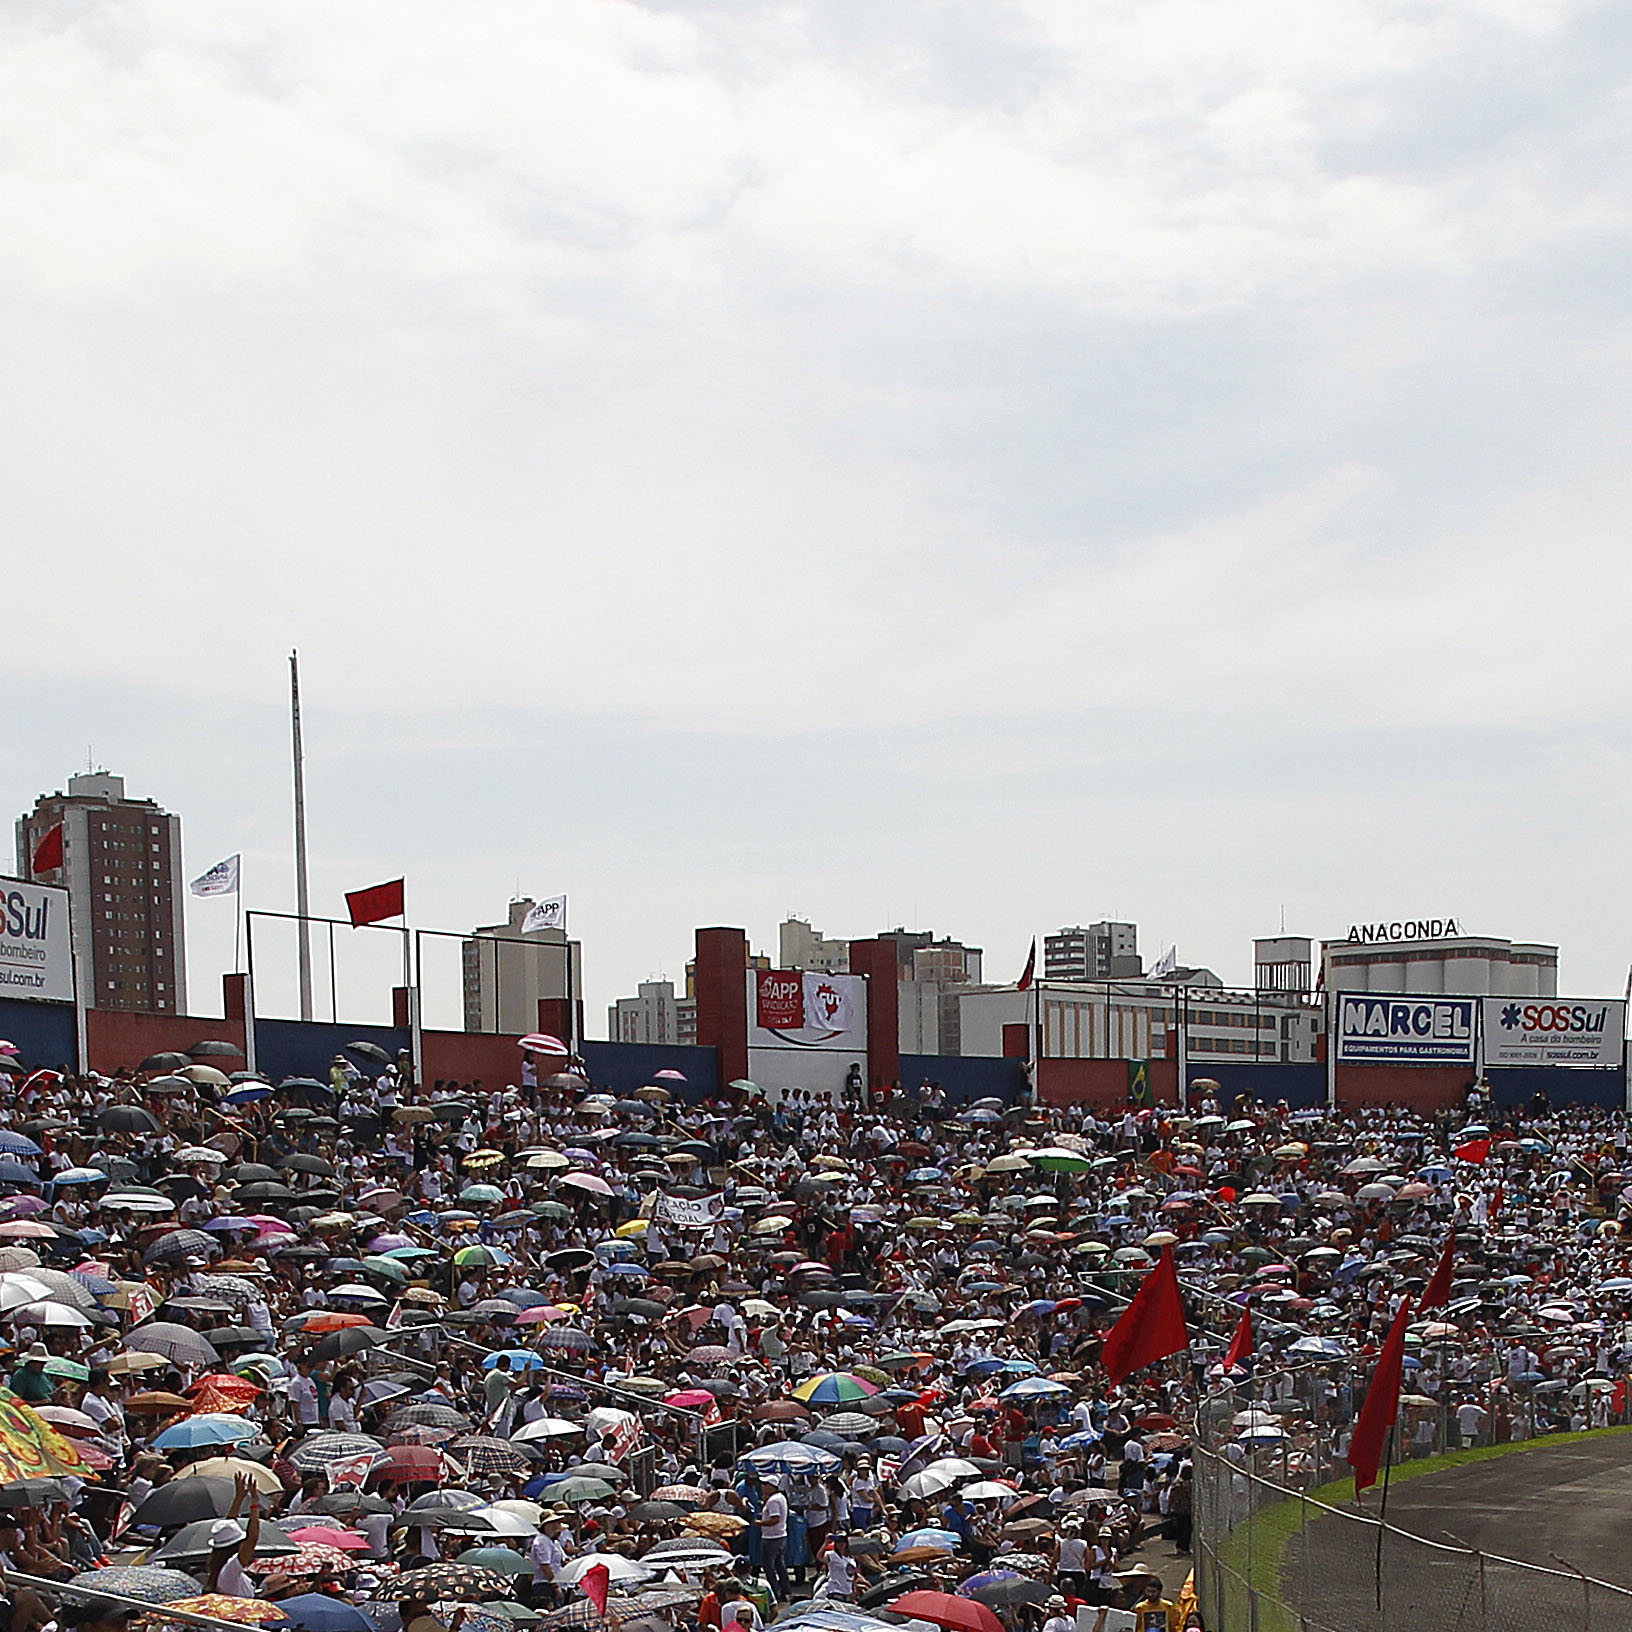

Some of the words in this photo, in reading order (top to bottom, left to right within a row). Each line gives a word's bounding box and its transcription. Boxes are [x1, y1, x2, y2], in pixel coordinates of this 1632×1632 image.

[1348, 919, 1458, 943] ANACONDA
[0, 942, 46, 962] bombeiro
[770, 982, 799, 1000] APP
[1344, 1002, 1470, 1037] NARCEL
[1521, 1005, 1607, 1032] SOSSul
[1550, 1034, 1561, 1043] do
[1399, 1046, 1418, 1054] PARA
